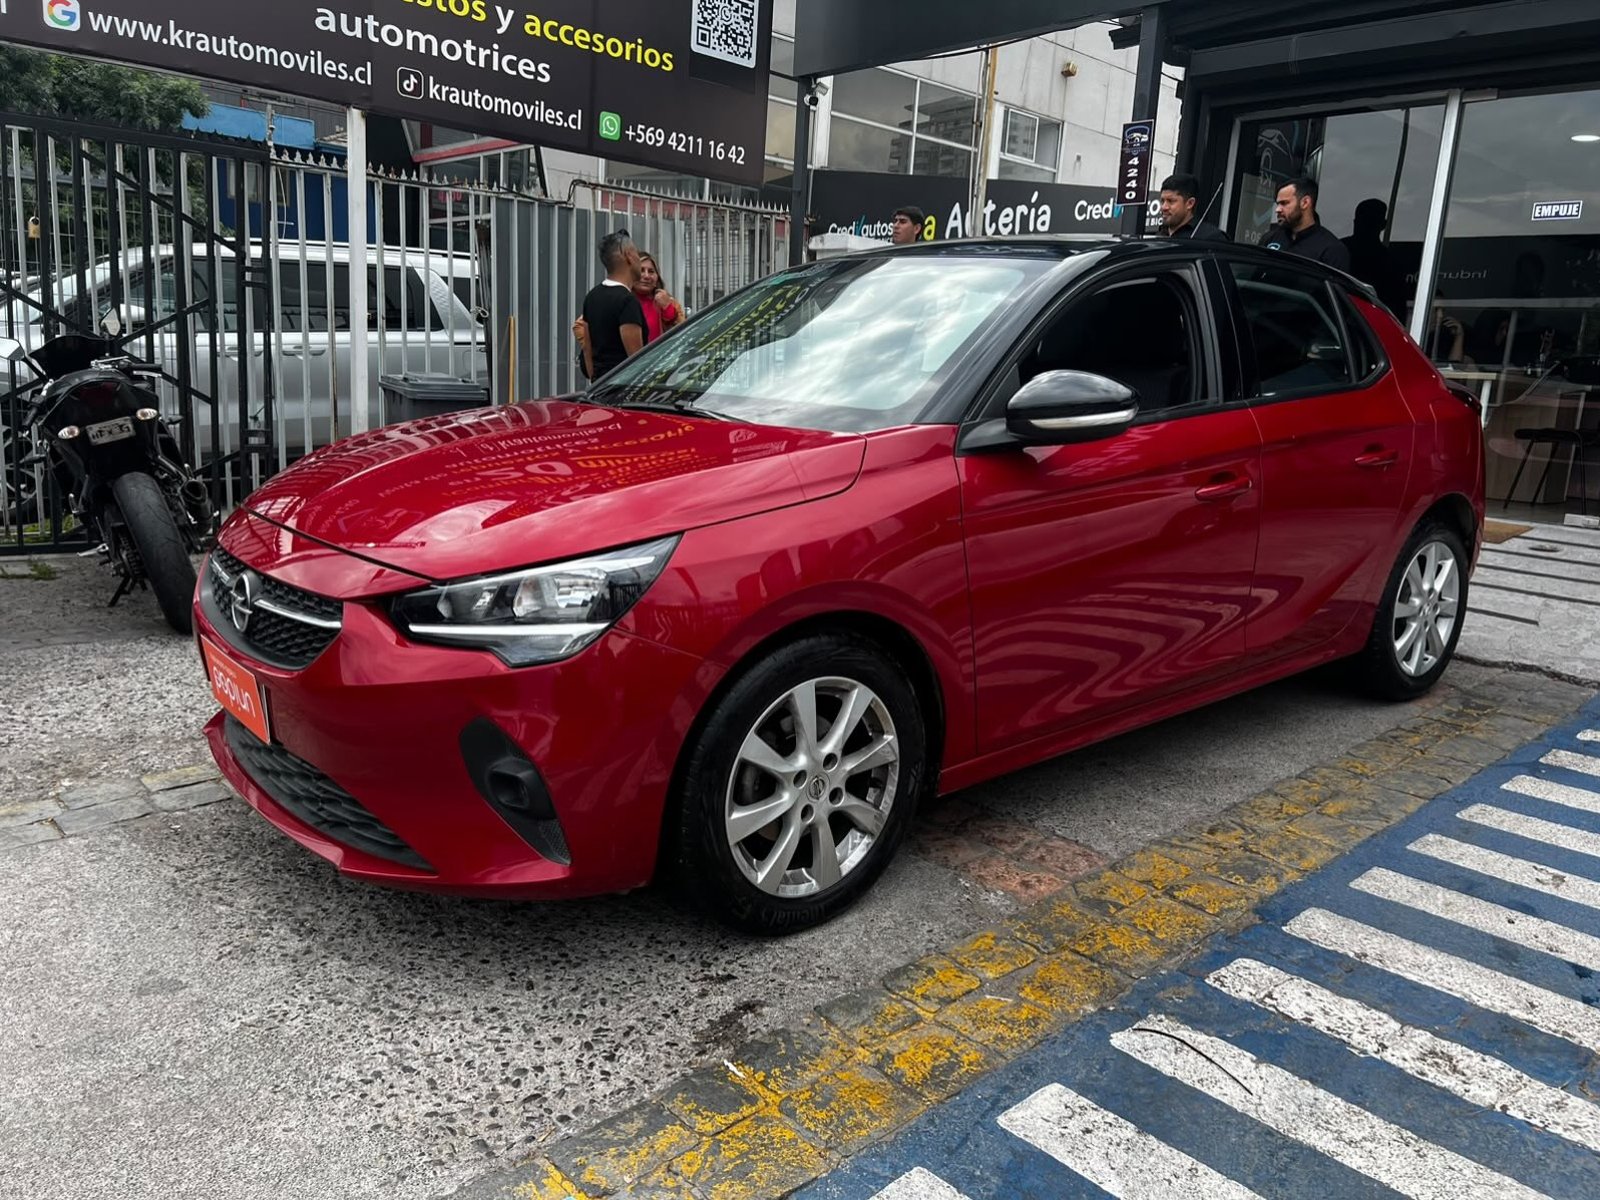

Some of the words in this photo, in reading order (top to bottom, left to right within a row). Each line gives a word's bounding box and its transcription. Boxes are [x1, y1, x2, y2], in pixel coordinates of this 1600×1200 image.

[87, 11, 372, 86] www.krautomoviles.cl
[315, 7, 551, 83] automotrices
[495, 5, 514, 34] y
[523, 14, 674, 72] accesorios
[429, 75, 582, 130] krautomoviles.cl
[625, 124, 665, 147] +569
[667, 132, 703, 156] 4211
[708, 140, 725, 160] 16
[727, 145, 745, 165] 42
[1535, 203, 1579, 217] EMPUJE
